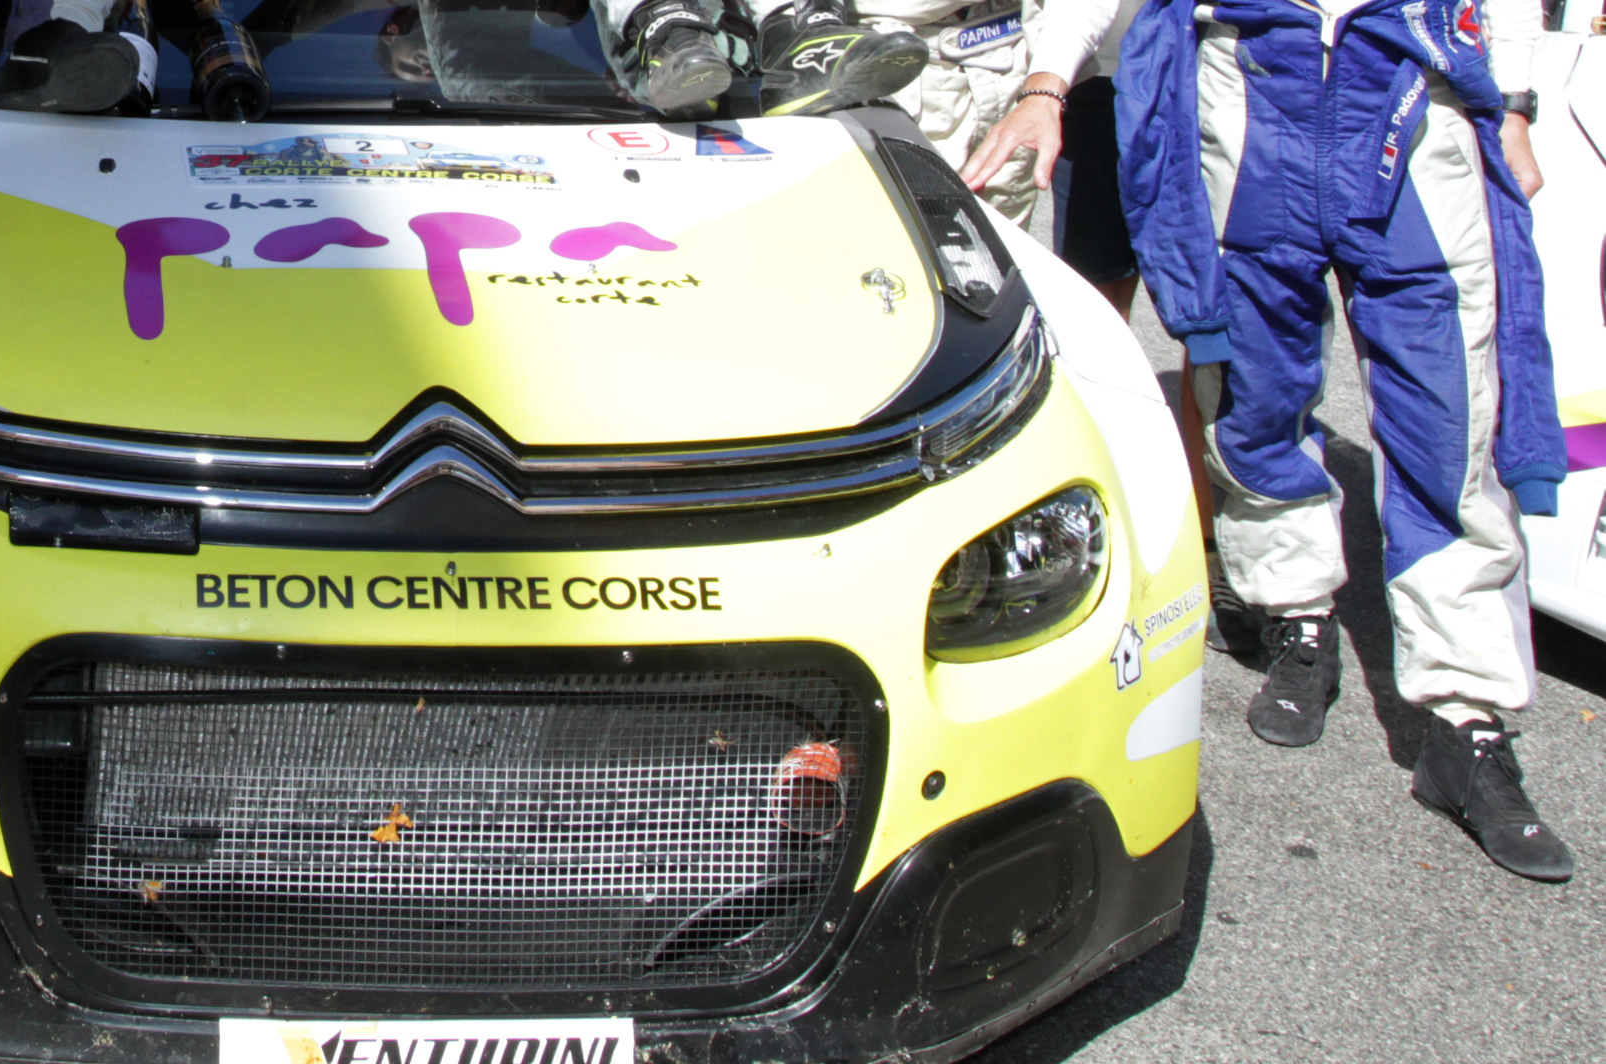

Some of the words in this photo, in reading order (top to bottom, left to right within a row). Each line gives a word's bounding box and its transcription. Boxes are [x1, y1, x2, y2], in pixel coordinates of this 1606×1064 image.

[959, 24, 1000, 48] PAPINI
[606, 131, 652, 148] E
[1386, 130, 1401, 144] R.
[355, 140, 375, 152] 2
[195, 154, 251, 168] 37
[252, 159, 346, 167] RALLYE
[244, 167, 334, 176] CORTE
[347, 168, 450, 179] CENTRE
[461, 171, 557, 184] CORSE
[205, 193, 318, 209] chez
[487, 271, 702, 288] restaurant
[556, 290, 661, 306] corte
[195, 573, 355, 610] BETON
[366, 575, 552, 611] CENTRE
[561, 576, 723, 611] CORSE
[1144, 599, 1183, 637] SPINOSI
[1184, 584, 1203, 611] ELEC
